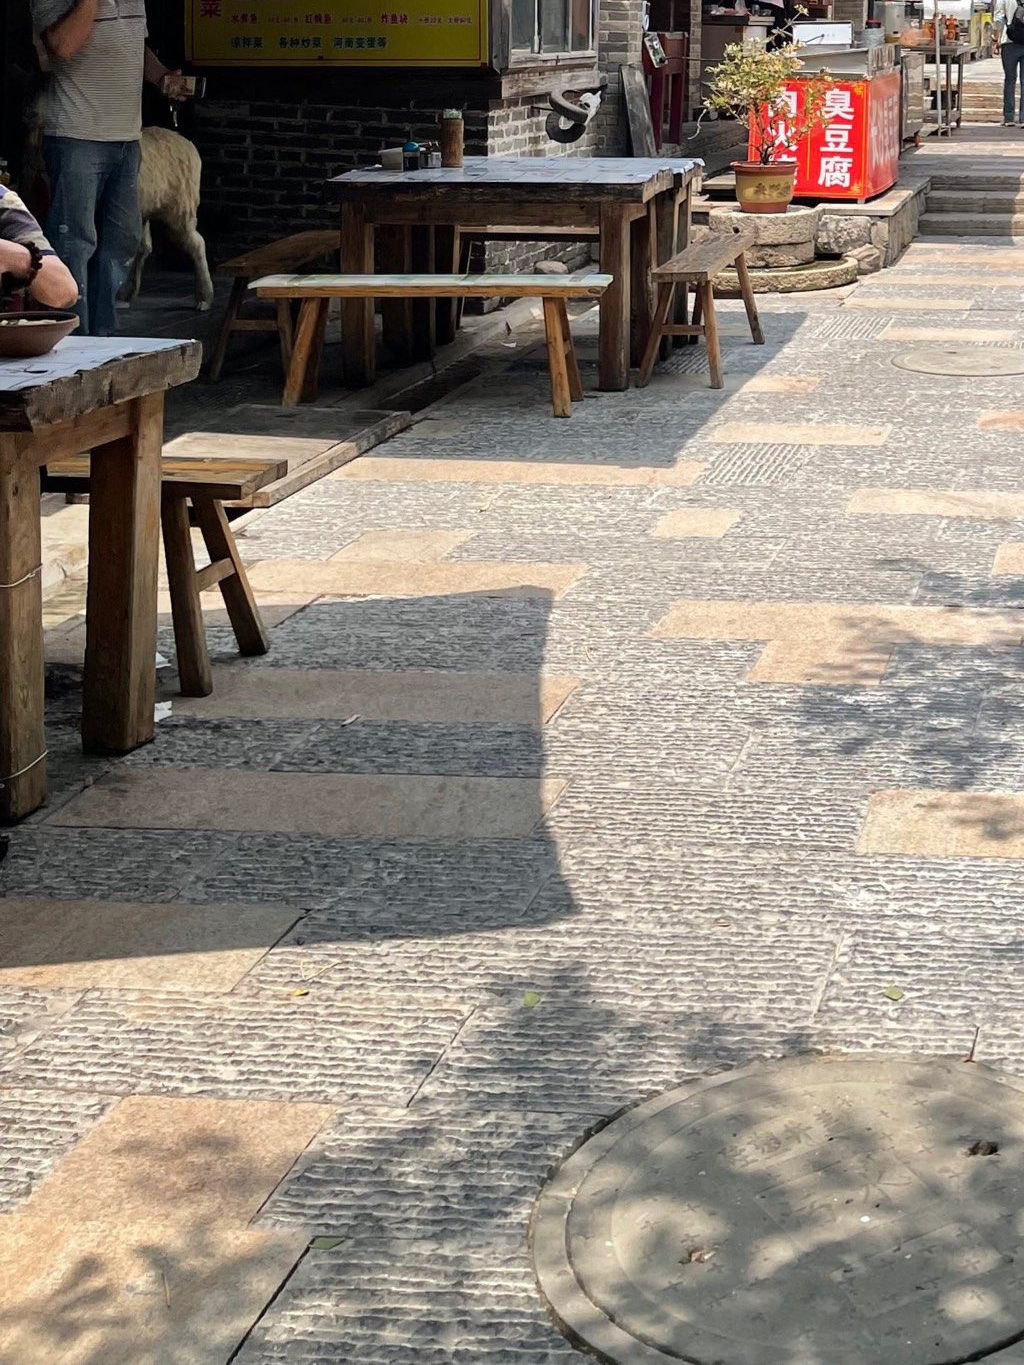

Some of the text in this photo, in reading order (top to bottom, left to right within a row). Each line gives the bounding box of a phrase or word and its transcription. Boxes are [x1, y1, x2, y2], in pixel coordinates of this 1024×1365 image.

[765, 88, 799, 186] 肉火
[818, 88, 855, 187] 臭豆腐
